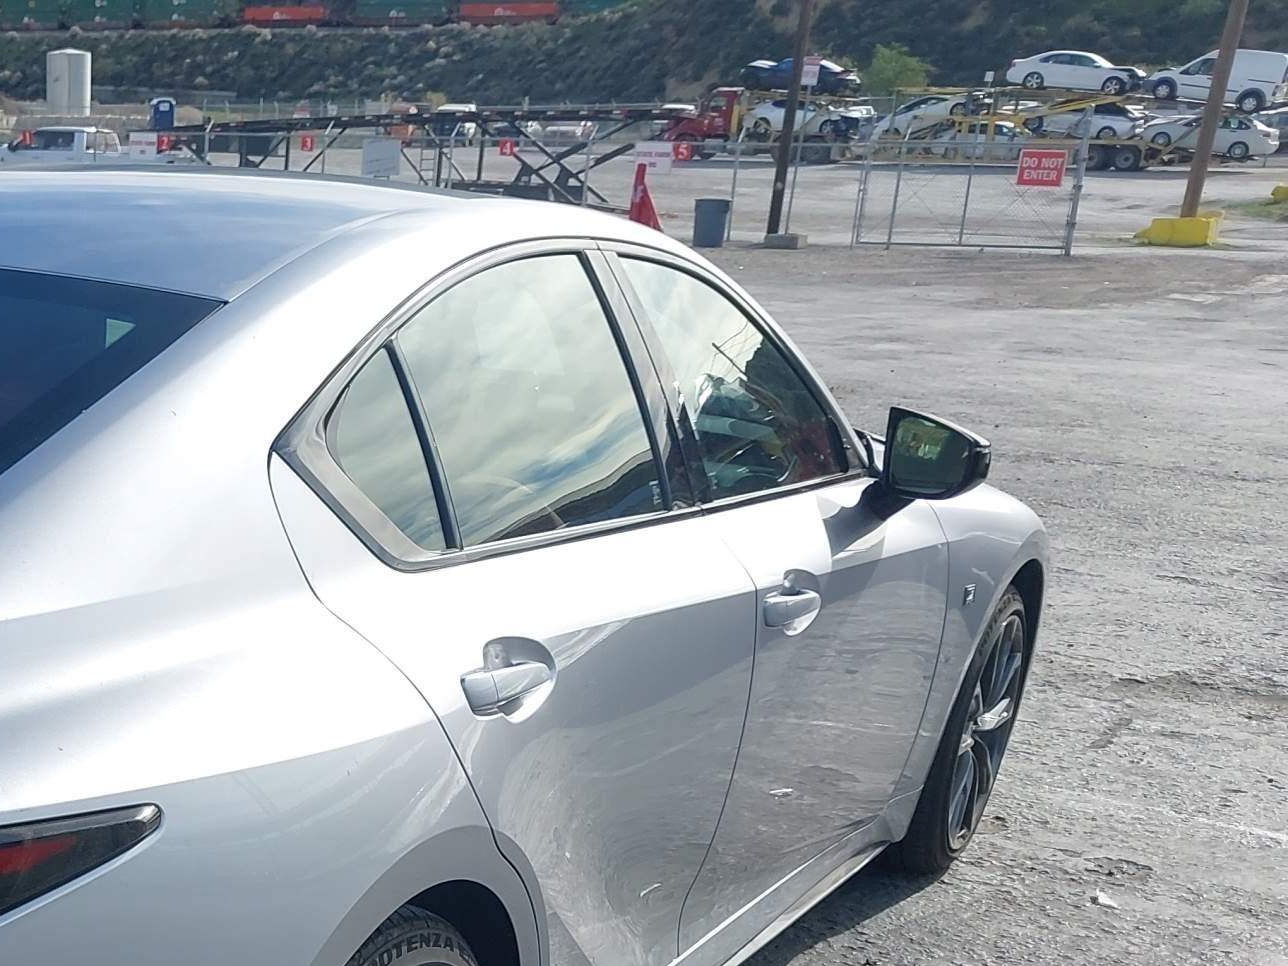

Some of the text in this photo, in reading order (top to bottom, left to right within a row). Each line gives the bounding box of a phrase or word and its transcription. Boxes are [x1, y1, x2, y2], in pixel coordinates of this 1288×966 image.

[1022, 157, 1065, 169] DO NOT
[1022, 169, 1058, 181] ENTER
